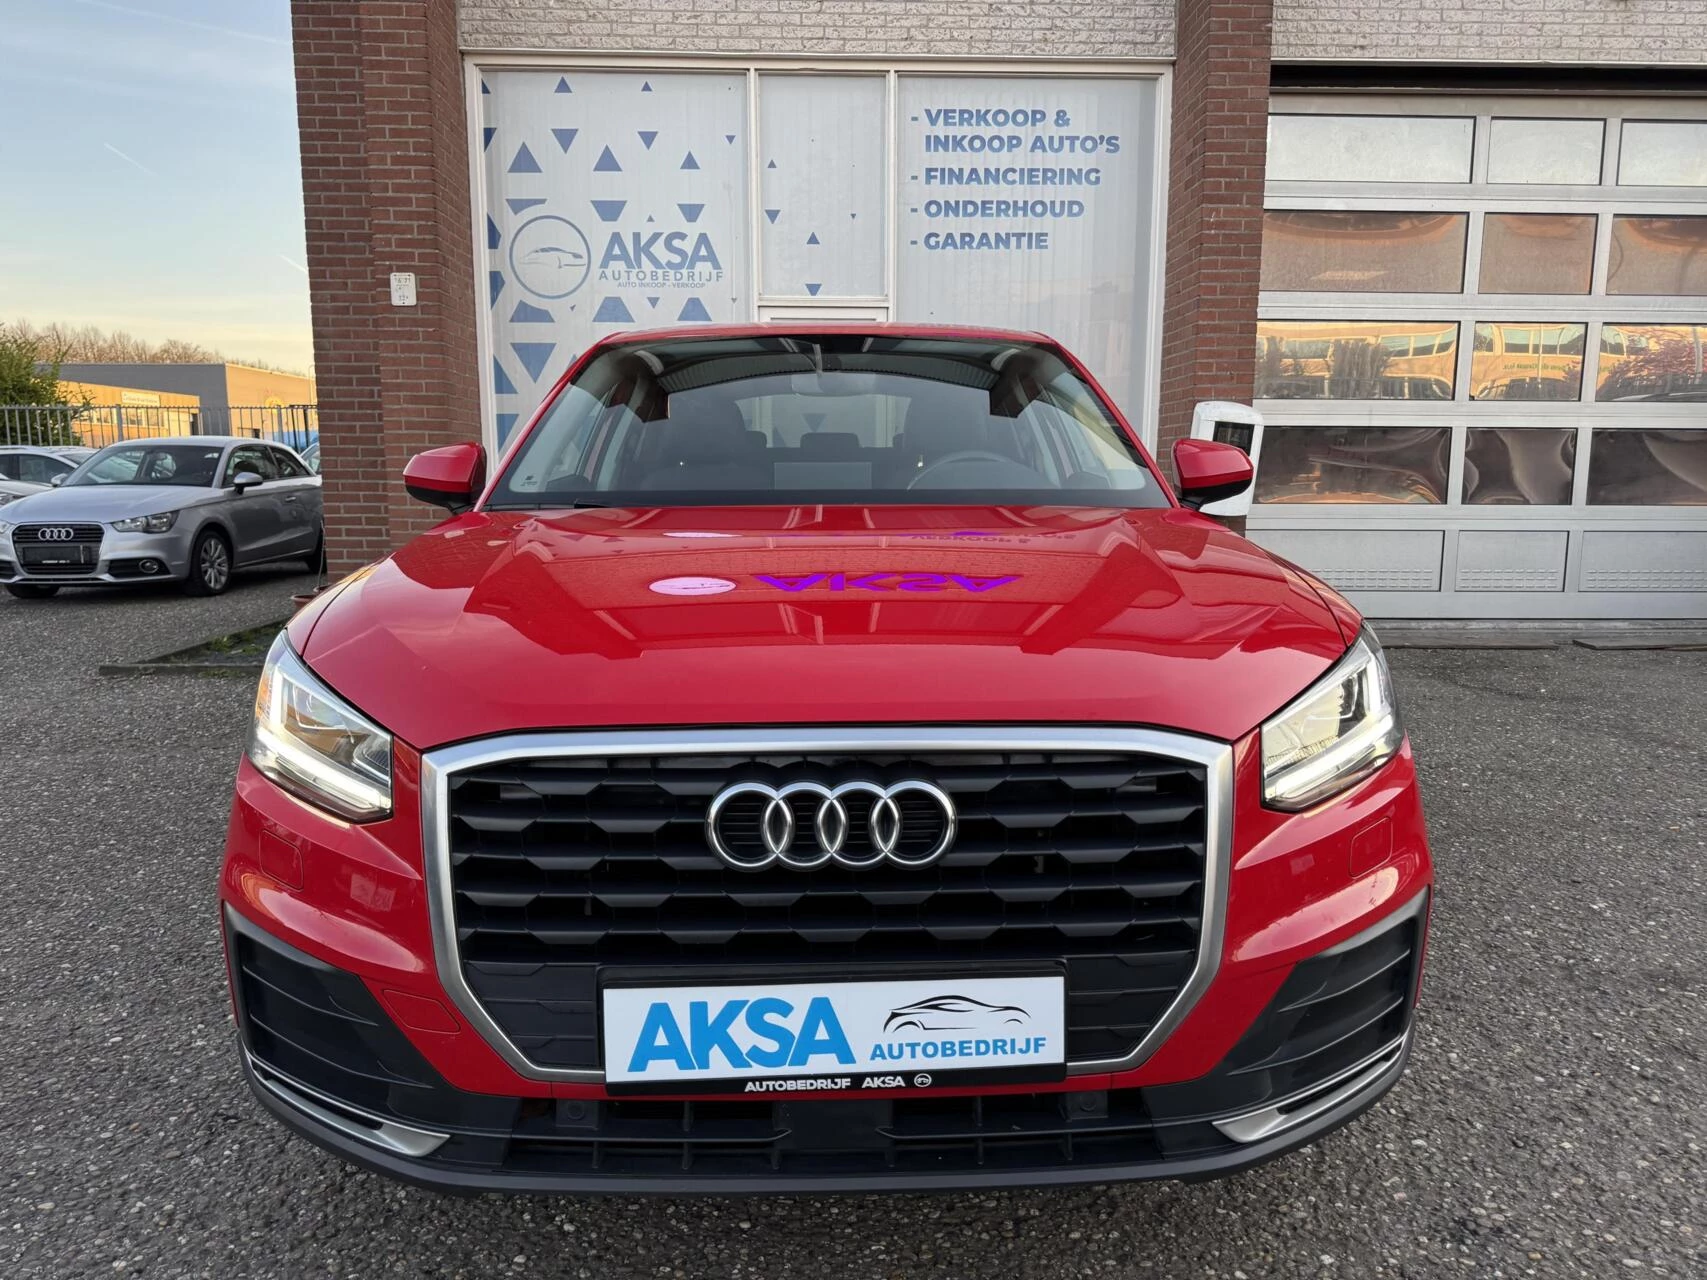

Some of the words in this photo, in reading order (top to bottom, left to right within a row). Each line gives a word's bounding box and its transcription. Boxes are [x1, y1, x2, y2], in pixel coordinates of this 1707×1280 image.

[924, 109, 1046, 127] VERKOOP
[1054, 109, 1070, 128] &
[925, 134, 1022, 153] INKOOP
[1029, 135, 1120, 153] AUTO'S
[924, 167, 1101, 185] FINANCIERING
[924, 200, 1085, 218] ONDERHOUD
[924, 232, 1049, 250] GARANTIE
[599, 231, 722, 270] AKSA
[599, 270, 723, 282] AUTOBEDRIJF
[627, 997, 856, 1073] AKSA
[870, 1037, 1046, 1061] AUTOBEDRIJF
[744, 1078, 851, 1092] AUTOBEDRIJF
[862, 1075, 906, 1089] AKSA
